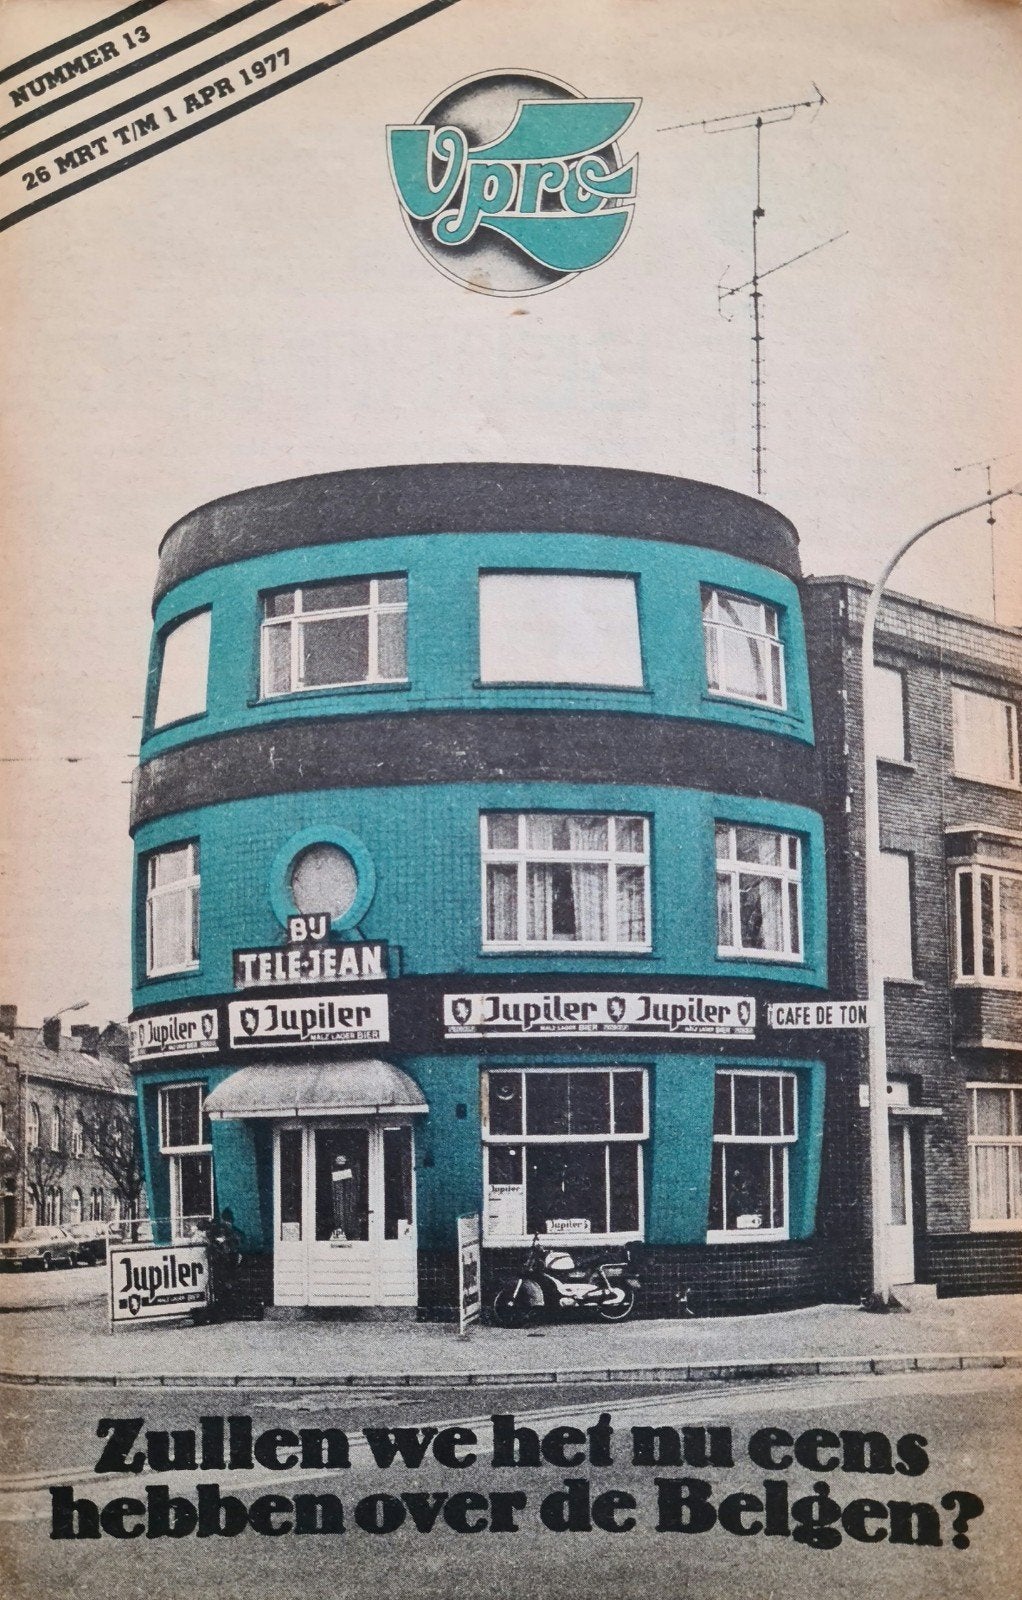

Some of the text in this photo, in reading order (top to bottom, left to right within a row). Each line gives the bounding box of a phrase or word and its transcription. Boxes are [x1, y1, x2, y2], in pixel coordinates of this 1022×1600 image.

[9, 25, 151, 107] NUMMER 13
[22, 47, 291, 190] 26 MRT T/M 1 APR 1977
[264, 1002, 371, 1040] Jupiler
[483, 996, 598, 1030] Jupiler
[636, 996, 731, 1030] Jupiler
[776, 1005, 867, 1026] CAFE DE TON
[148, 1016, 197, 1049] Jupiler
[356, 1030, 379, 1039] BIER
[120, 1254, 204, 1301] Jupiler
[95, 1413, 930, 1477] Zullen we het nu eens
[49, 1478, 985, 1550] hebben over de Belgen?
